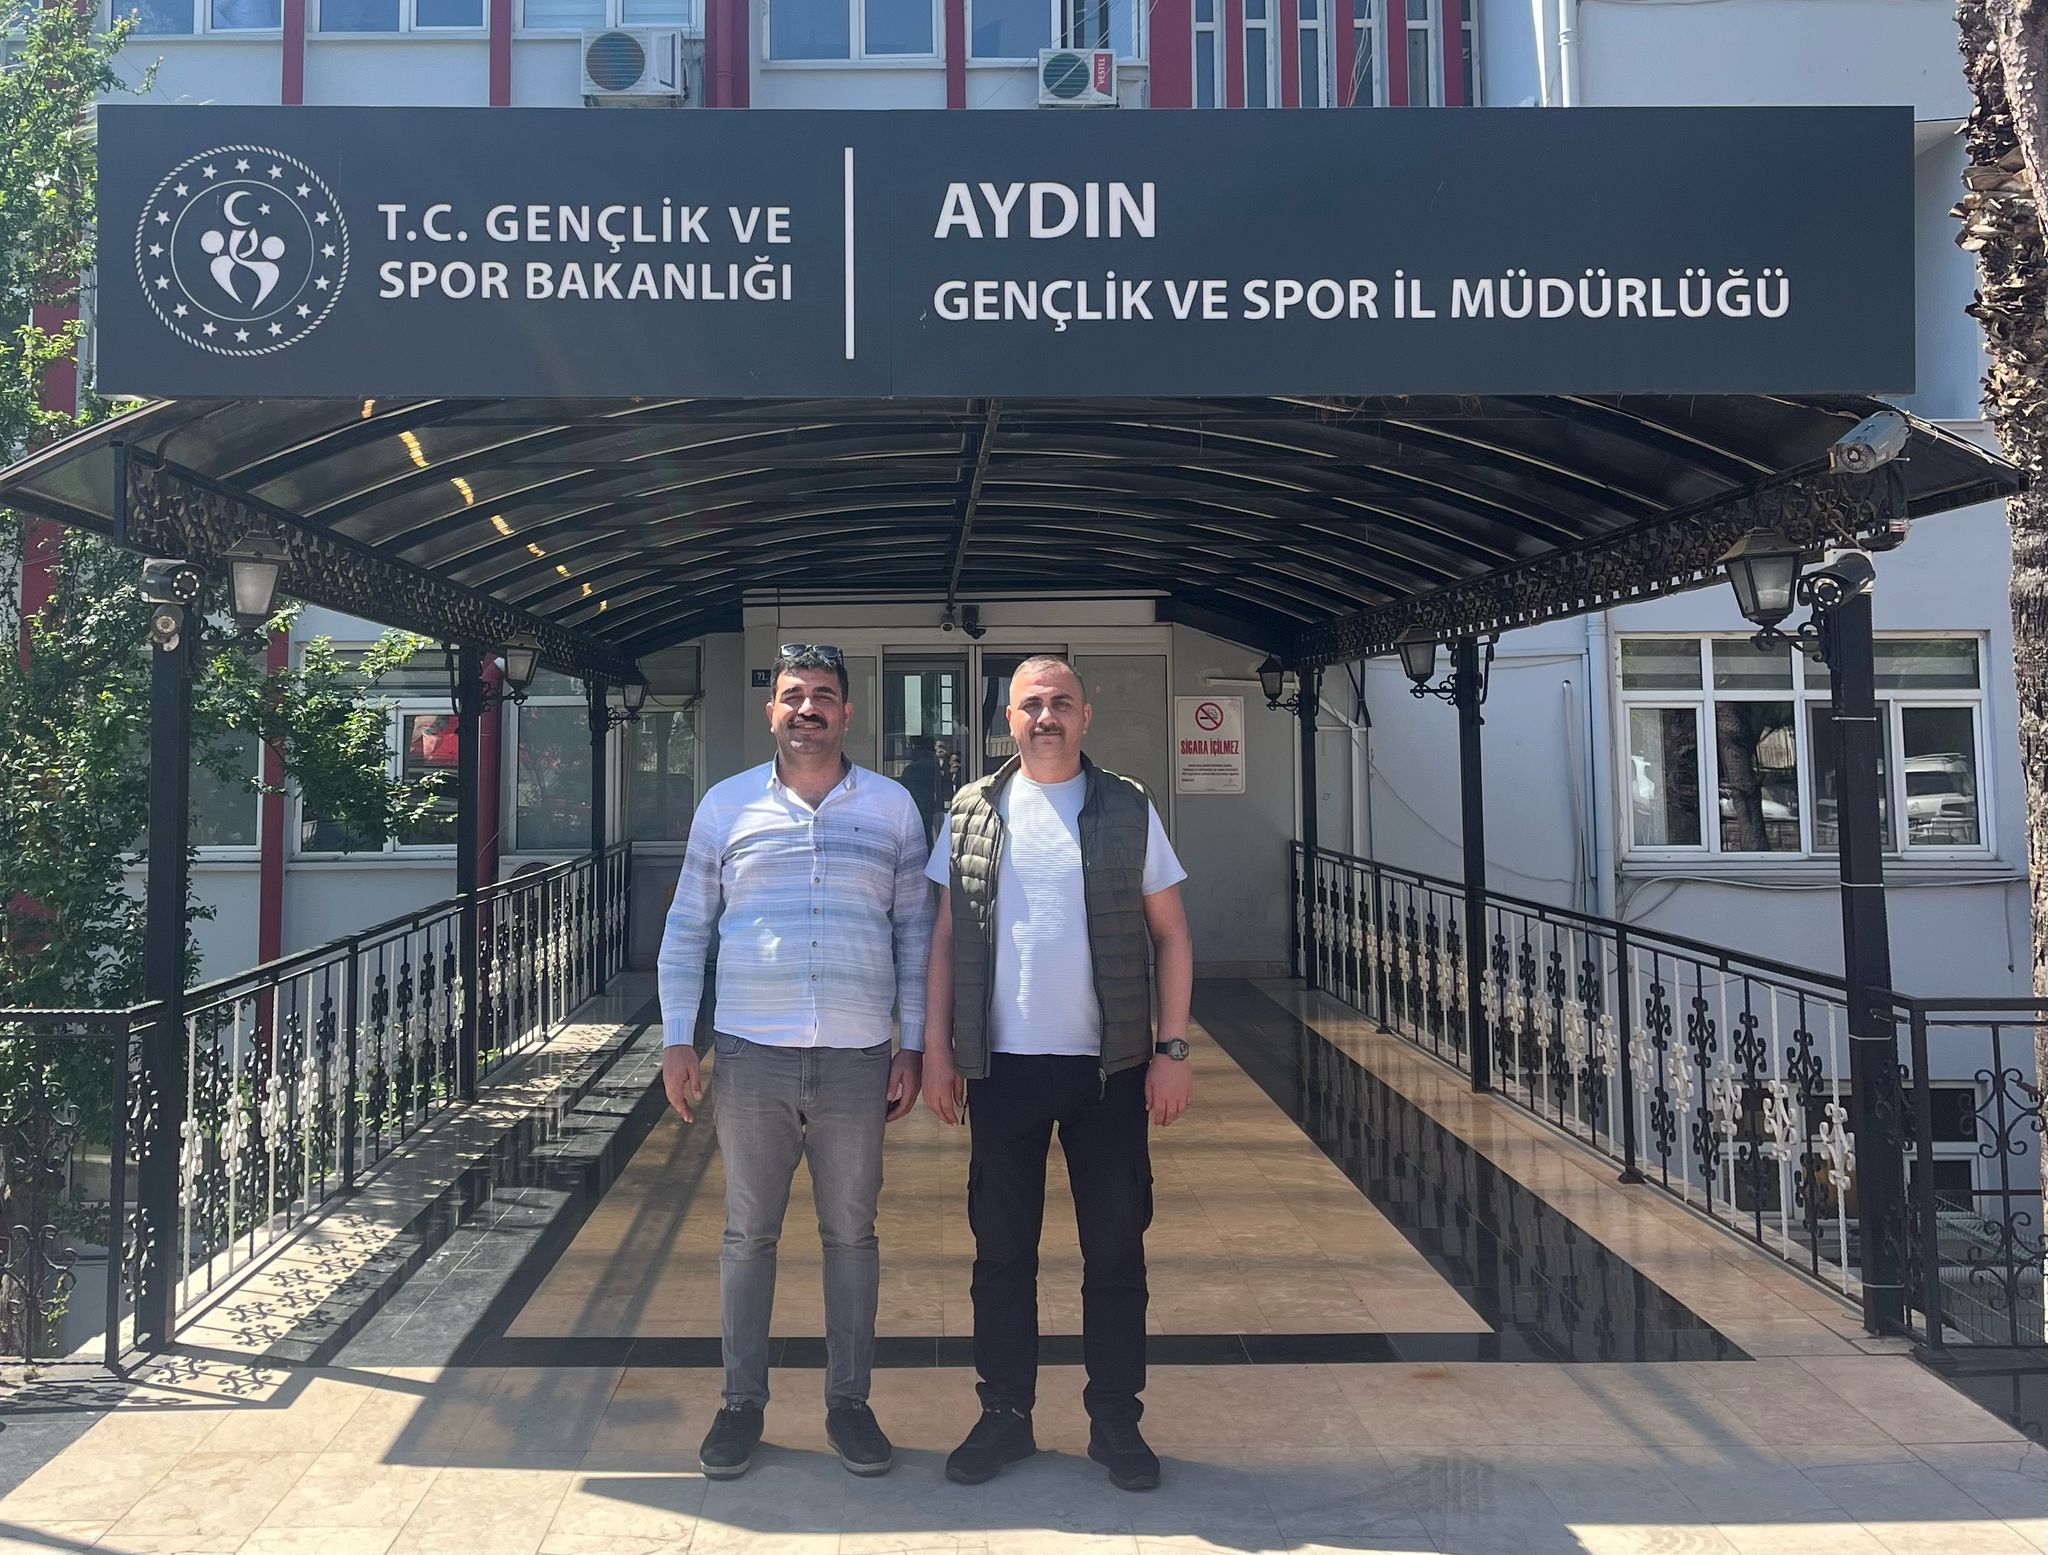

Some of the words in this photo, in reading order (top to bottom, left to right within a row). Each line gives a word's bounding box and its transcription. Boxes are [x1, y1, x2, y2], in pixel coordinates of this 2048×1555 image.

[377, 203, 468, 243] T.C.
[485, 197, 710, 254] GENÇLİK
[728, 206, 792, 245] VE
[934, 182, 1156, 239] AYDIN
[378, 260, 509, 300] SPOR
[526, 256, 792, 301] BAKANLIĞI
[933, 270, 1155, 332] GENÇLİK
[1163, 280, 1230, 320] VE
[1243, 279, 1380, 320] SPOR
[1394, 269, 1437, 319] İL
[1451, 268, 1791, 319] MÜDÜRLÜĞÜ
[1180, 738, 1208, 755] SİGARA
[1210, 738, 1239, 757] İÇİLMEZ
